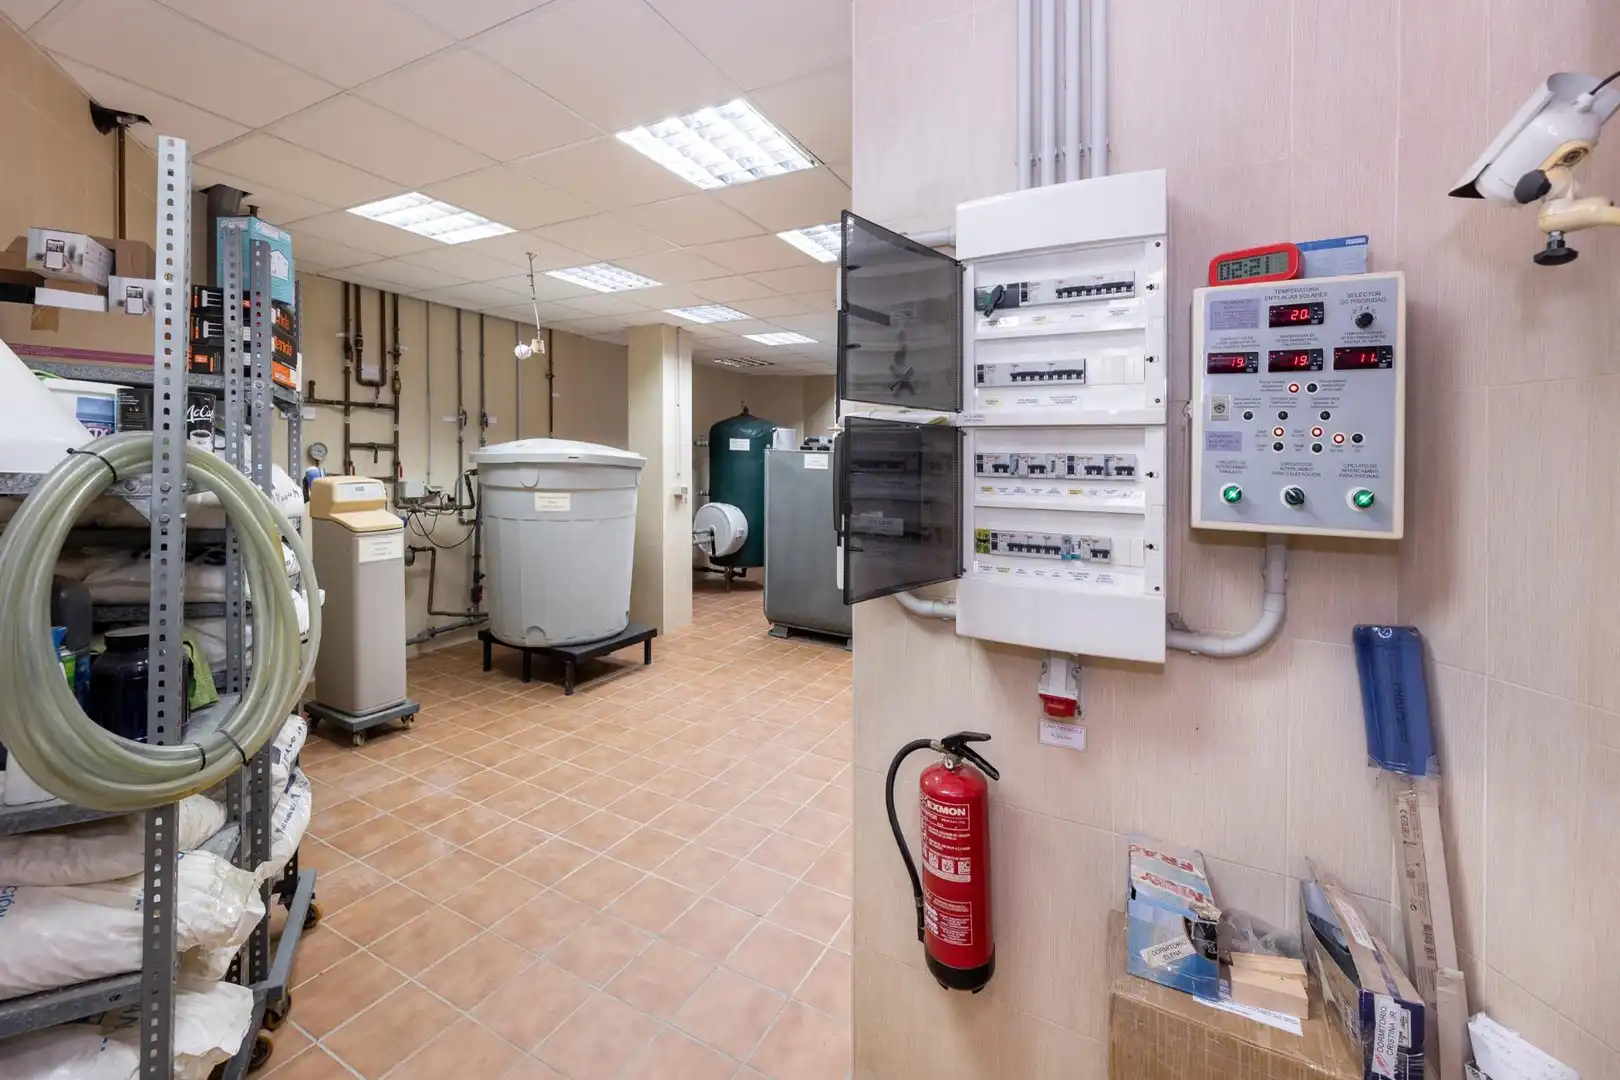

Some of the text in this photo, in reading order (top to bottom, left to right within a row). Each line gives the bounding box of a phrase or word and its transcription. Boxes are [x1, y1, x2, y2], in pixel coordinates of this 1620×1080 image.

[1219, 255, 1270, 282] 02:21
[1290, 308, 1310, 321] 20
[1231, 357, 1245, 368] 19
[1293, 354, 1309, 366] 19
[927, 800, 966, 817] EXMON
[1151, 939, 1187, 957] DORMITORIO
[1162, 949, 1183, 961] ELENA
[1376, 1005, 1388, 1054] DORMITORIO
[1386, 1021, 1396, 1056] CRISTINA
